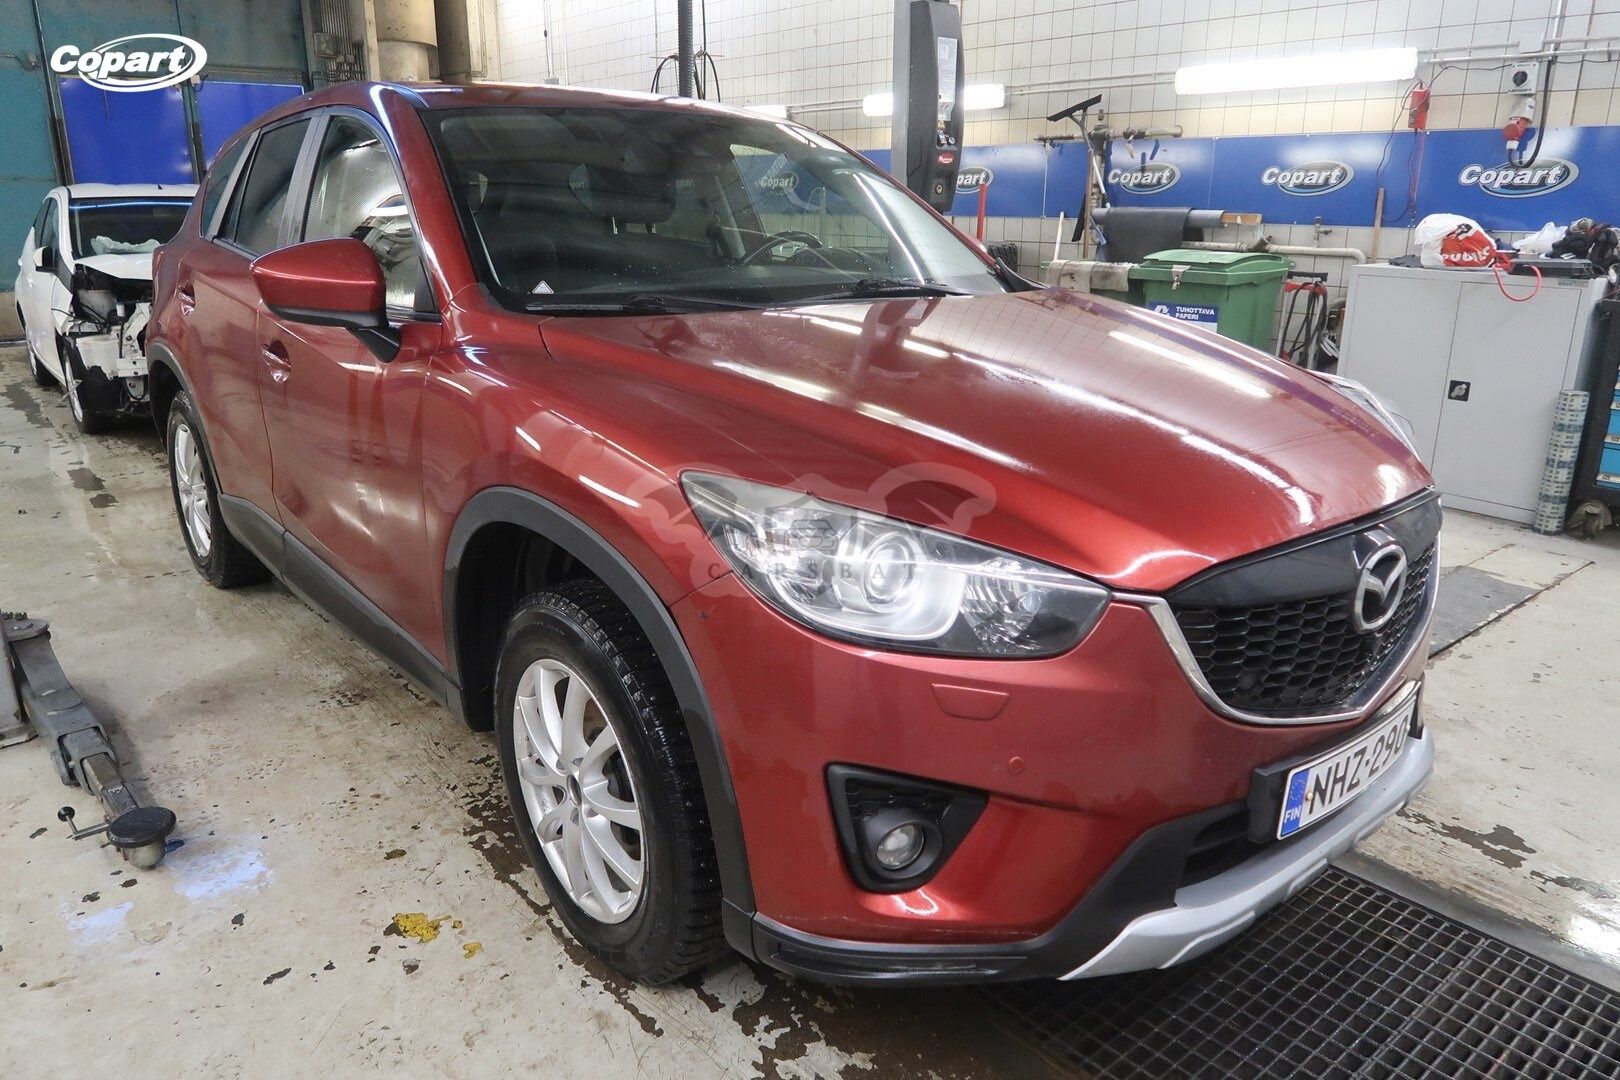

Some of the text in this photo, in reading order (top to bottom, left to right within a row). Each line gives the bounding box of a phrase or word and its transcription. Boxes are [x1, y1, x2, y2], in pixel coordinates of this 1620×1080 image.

[957, 169, 987, 186] part
[1108, 167, 1171, 187] Copart
[1261, 165, 1343, 188] Copart
[1459, 164, 1562, 189] Copart
[1175, 306, 1216, 316] TUHOTTAVA
[1175, 313, 1200, 321] PAPERI
[1308, 714, 1410, 816] NHZ-290
[1284, 804, 1303, 824] FIN
